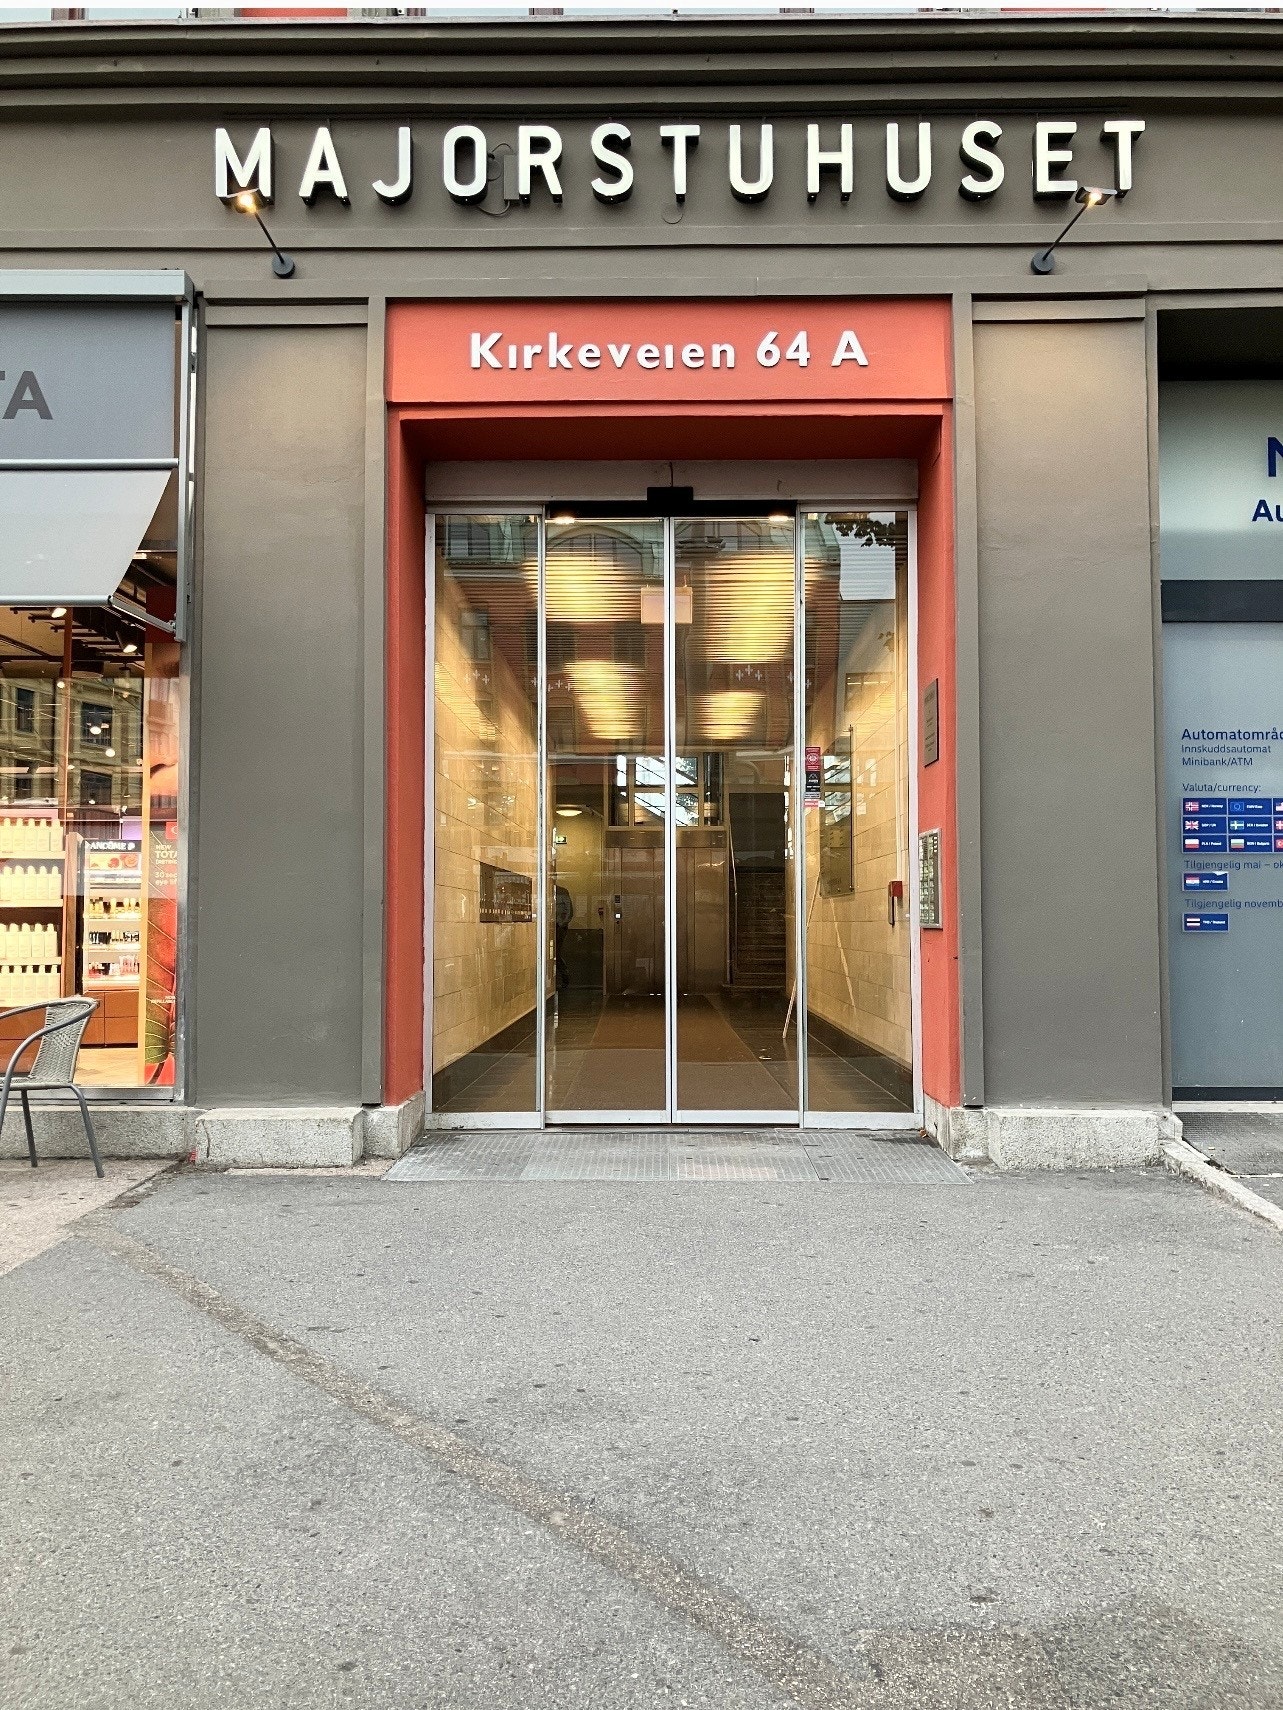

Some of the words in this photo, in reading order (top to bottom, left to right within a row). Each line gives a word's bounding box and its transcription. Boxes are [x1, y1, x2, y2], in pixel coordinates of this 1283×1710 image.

[215, 120, 1146, 200] MAJORSTUHUSET
[756, 330, 811, 368] 64
[831, 329, 870, 368] A
[0, 370, 54, 420] A
[1181, 744, 1271, 754] Innskuddsautomat
[1181, 756, 1253, 767] Minibank/ATM
[1181, 782, 1262, 794] Valuta/currency:
[1184, 860, 1241, 871] Tilgjengelig
[1184, 899, 1242, 910] Tilgjengelig
